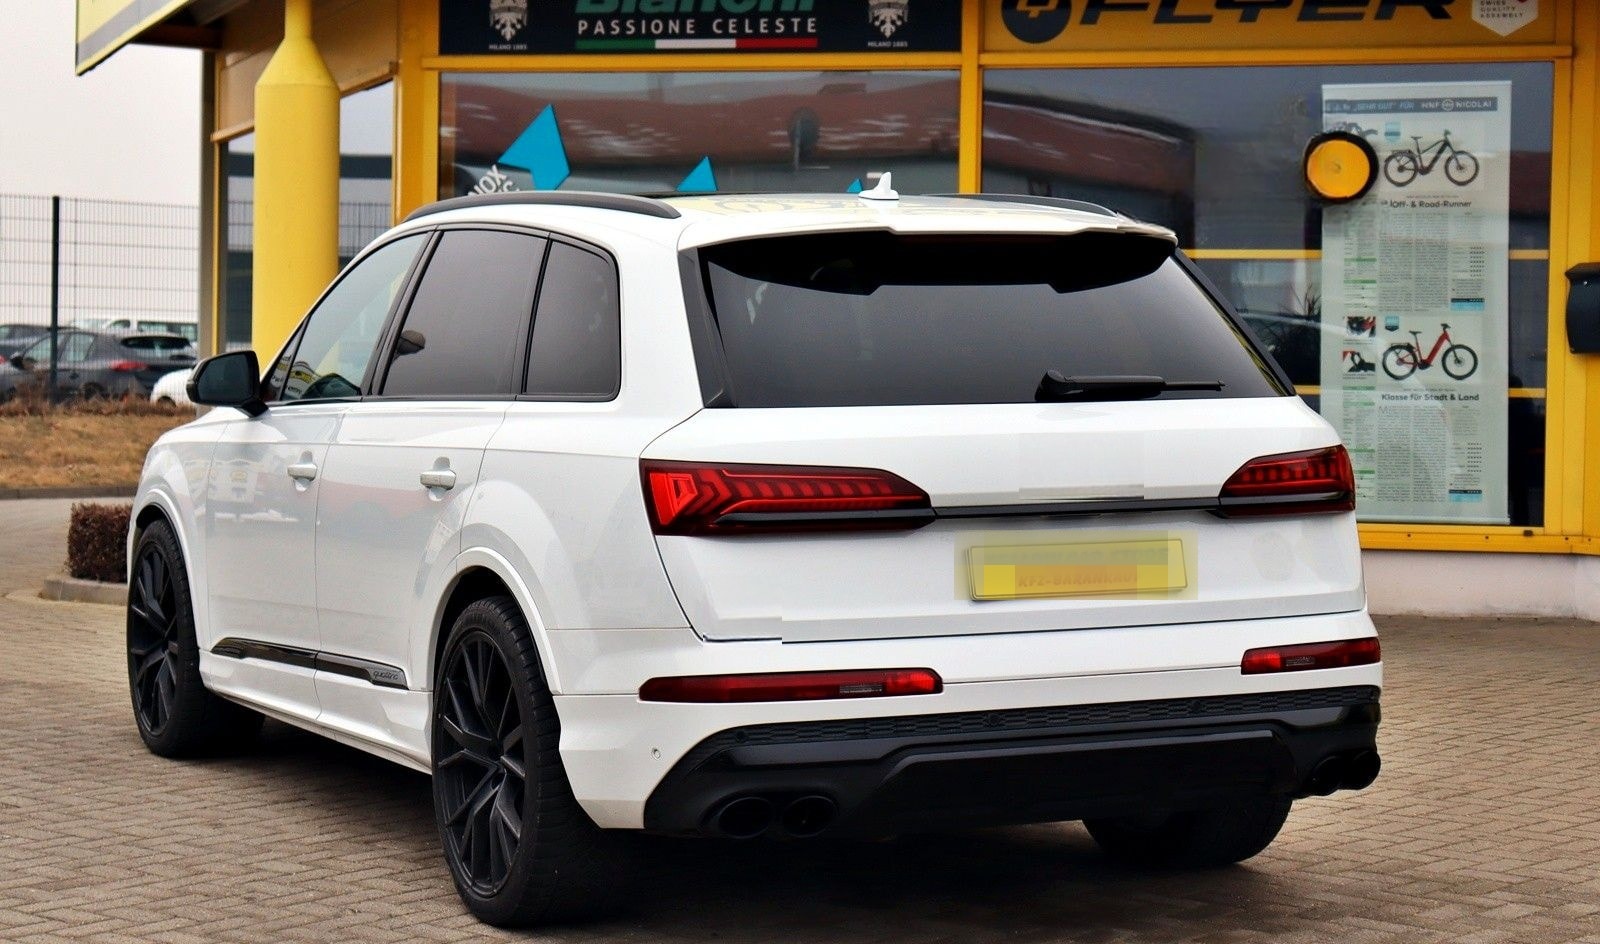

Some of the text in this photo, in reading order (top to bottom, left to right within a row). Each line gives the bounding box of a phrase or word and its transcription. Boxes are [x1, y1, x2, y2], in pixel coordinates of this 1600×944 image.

[1080, 0, 1455, 25] FLYER
[577, 17, 818, 35] PASSIONE CELESTE
[1455, 100, 1492, 108] NICOLAI
[1419, 200, 1472, 208] Road-Runner
[1382, 393, 1409, 401] Klasse
[1410, 393, 1423, 401] für
[1424, 393, 1448, 401] Stadt
[1458, 393, 1480, 401] Land
